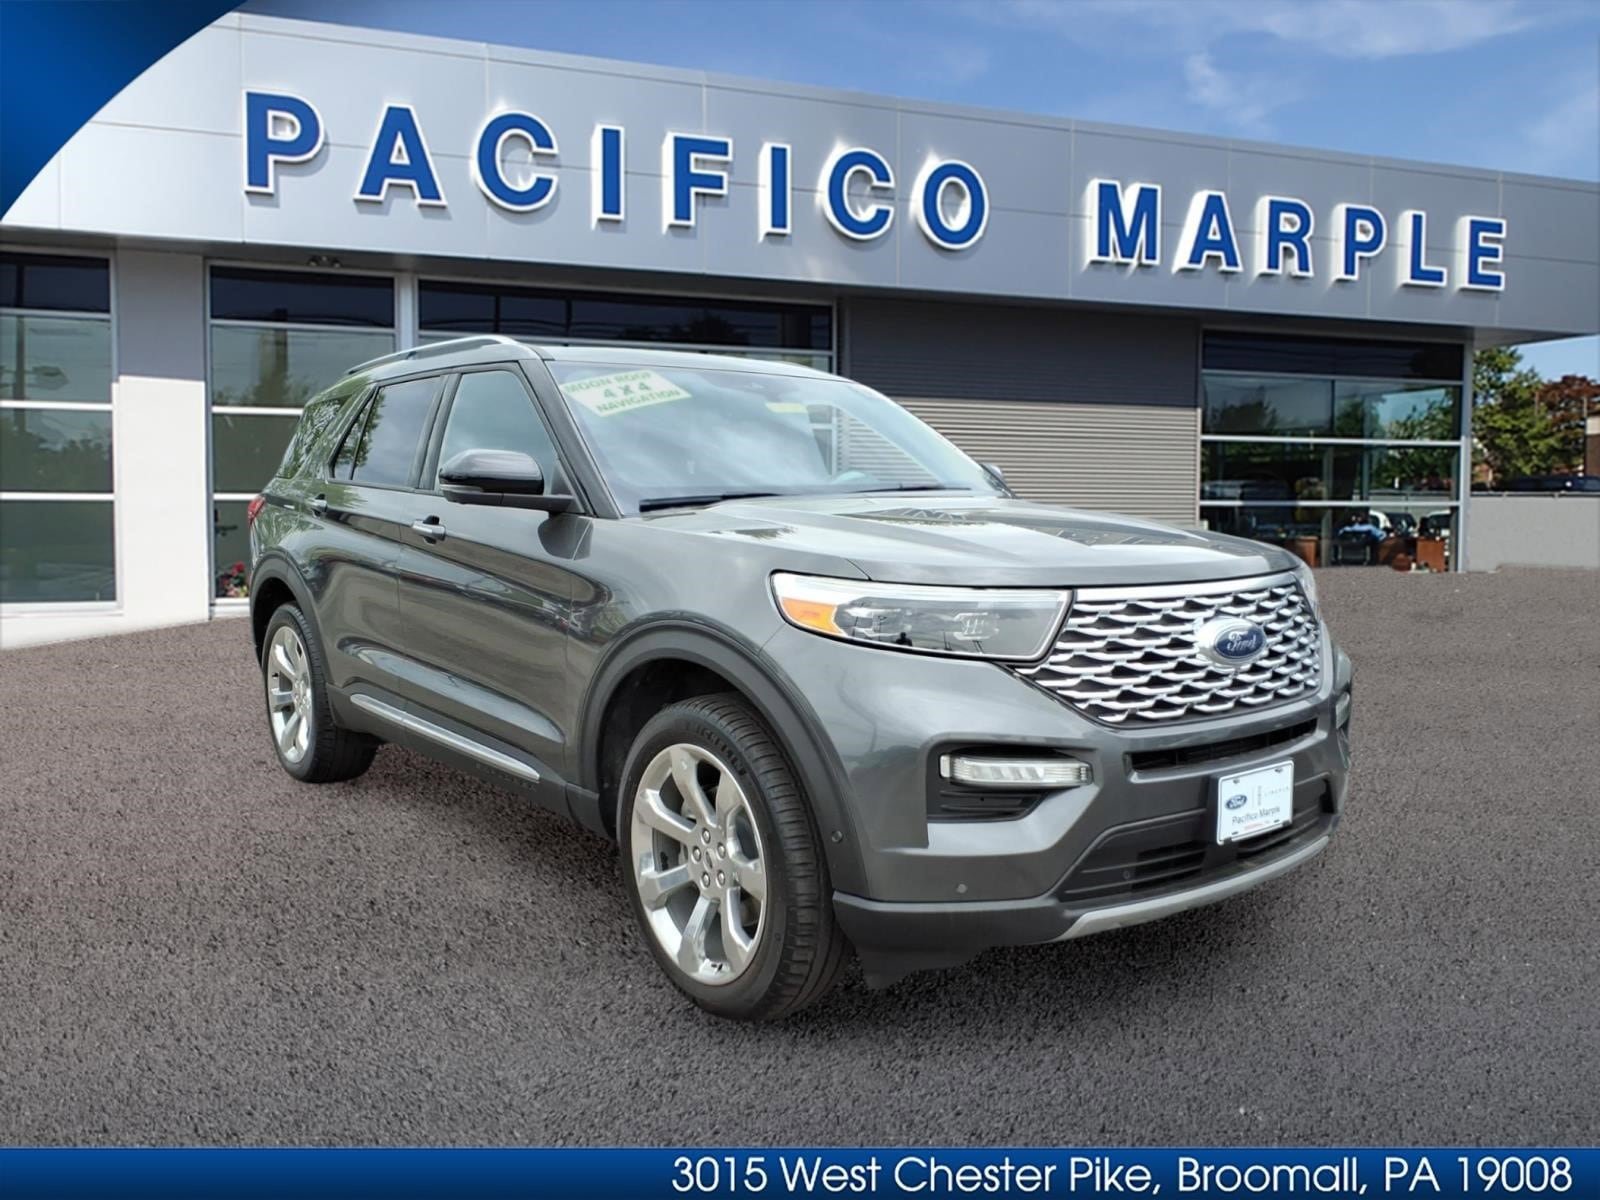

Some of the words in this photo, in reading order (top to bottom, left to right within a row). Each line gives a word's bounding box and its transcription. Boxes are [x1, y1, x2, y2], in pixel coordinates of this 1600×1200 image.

[243, 90, 988, 248] PACIFICO
[1091, 180, 1507, 290] MARPLE
[596, 389, 681, 412] NAVIGATION
[1226, 629, 1257, 652] Ford
